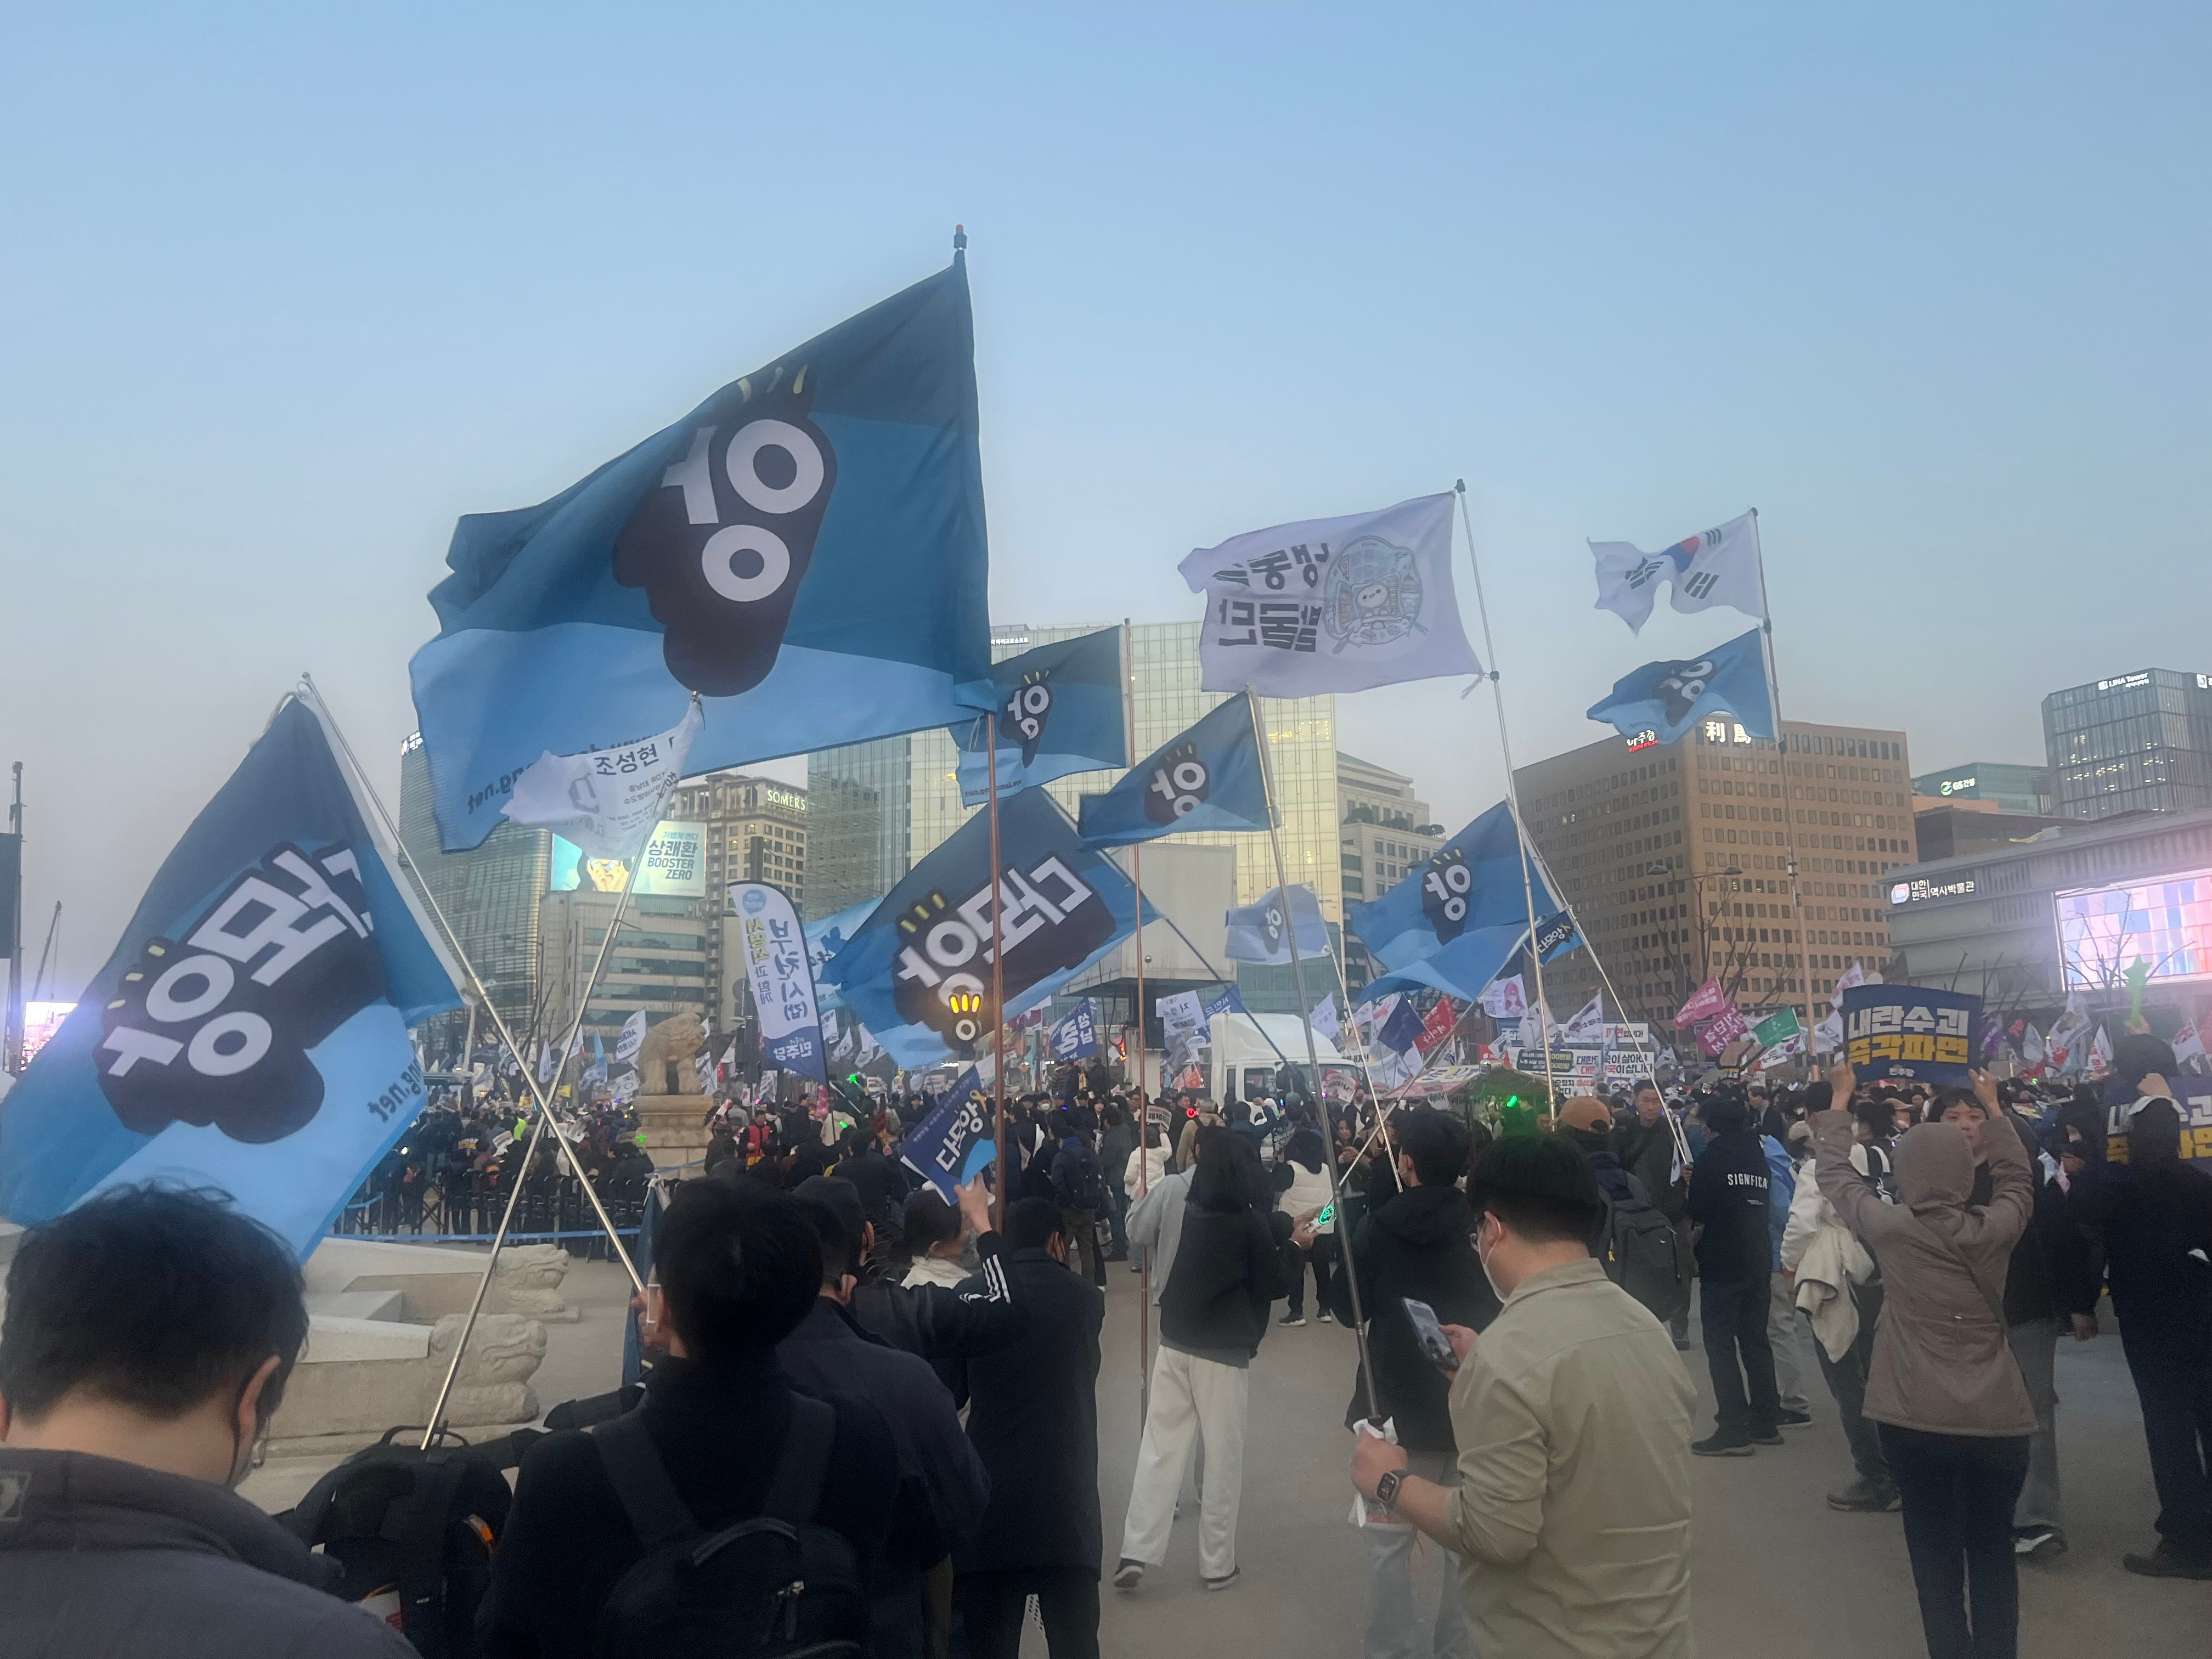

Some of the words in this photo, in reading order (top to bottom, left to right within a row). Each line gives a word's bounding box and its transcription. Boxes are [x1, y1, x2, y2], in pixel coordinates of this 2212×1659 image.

[2109, 676, 2126, 687] LINA
[2126, 673, 2149, 682] Tower
[594, 743, 659, 776] 조성현
[768, 789, 808, 811] SOMERS
[648, 840, 698, 857] 상쾌환
[647, 857, 695, 870] BOOSTER
[665, 869, 692, 880] ZERO
[1911, 879, 1927, 890] 대한
[1930, 881, 1974, 898] 역사박물관
[1911, 889, 1927, 901] 민국
[1848, 1005, 1970, 1040] 내란수괴
[1848, 1035, 1968, 1065] 즉각파면
[935, 1101, 984, 1172] 다모앙
